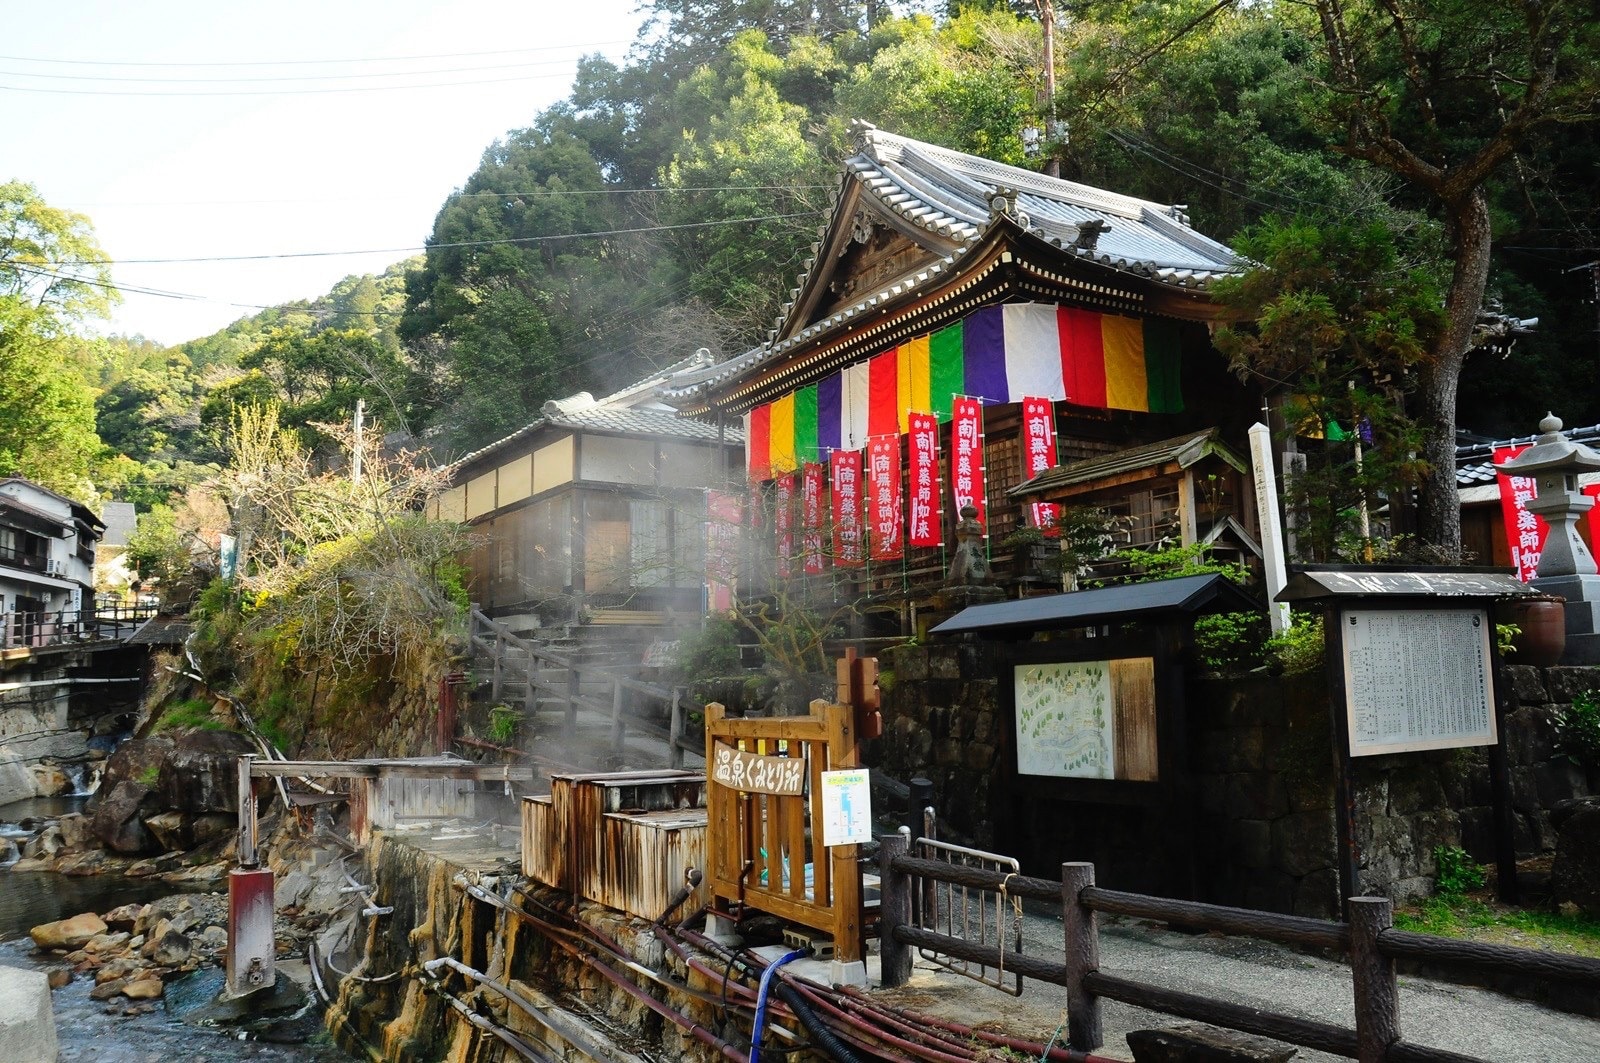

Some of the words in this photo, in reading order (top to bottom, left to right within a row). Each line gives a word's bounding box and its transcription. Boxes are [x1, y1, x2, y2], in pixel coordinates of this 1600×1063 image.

[914, 431, 932, 539] 南無薬師如来
[717, 750, 800, 793] 温泉くみとり所
